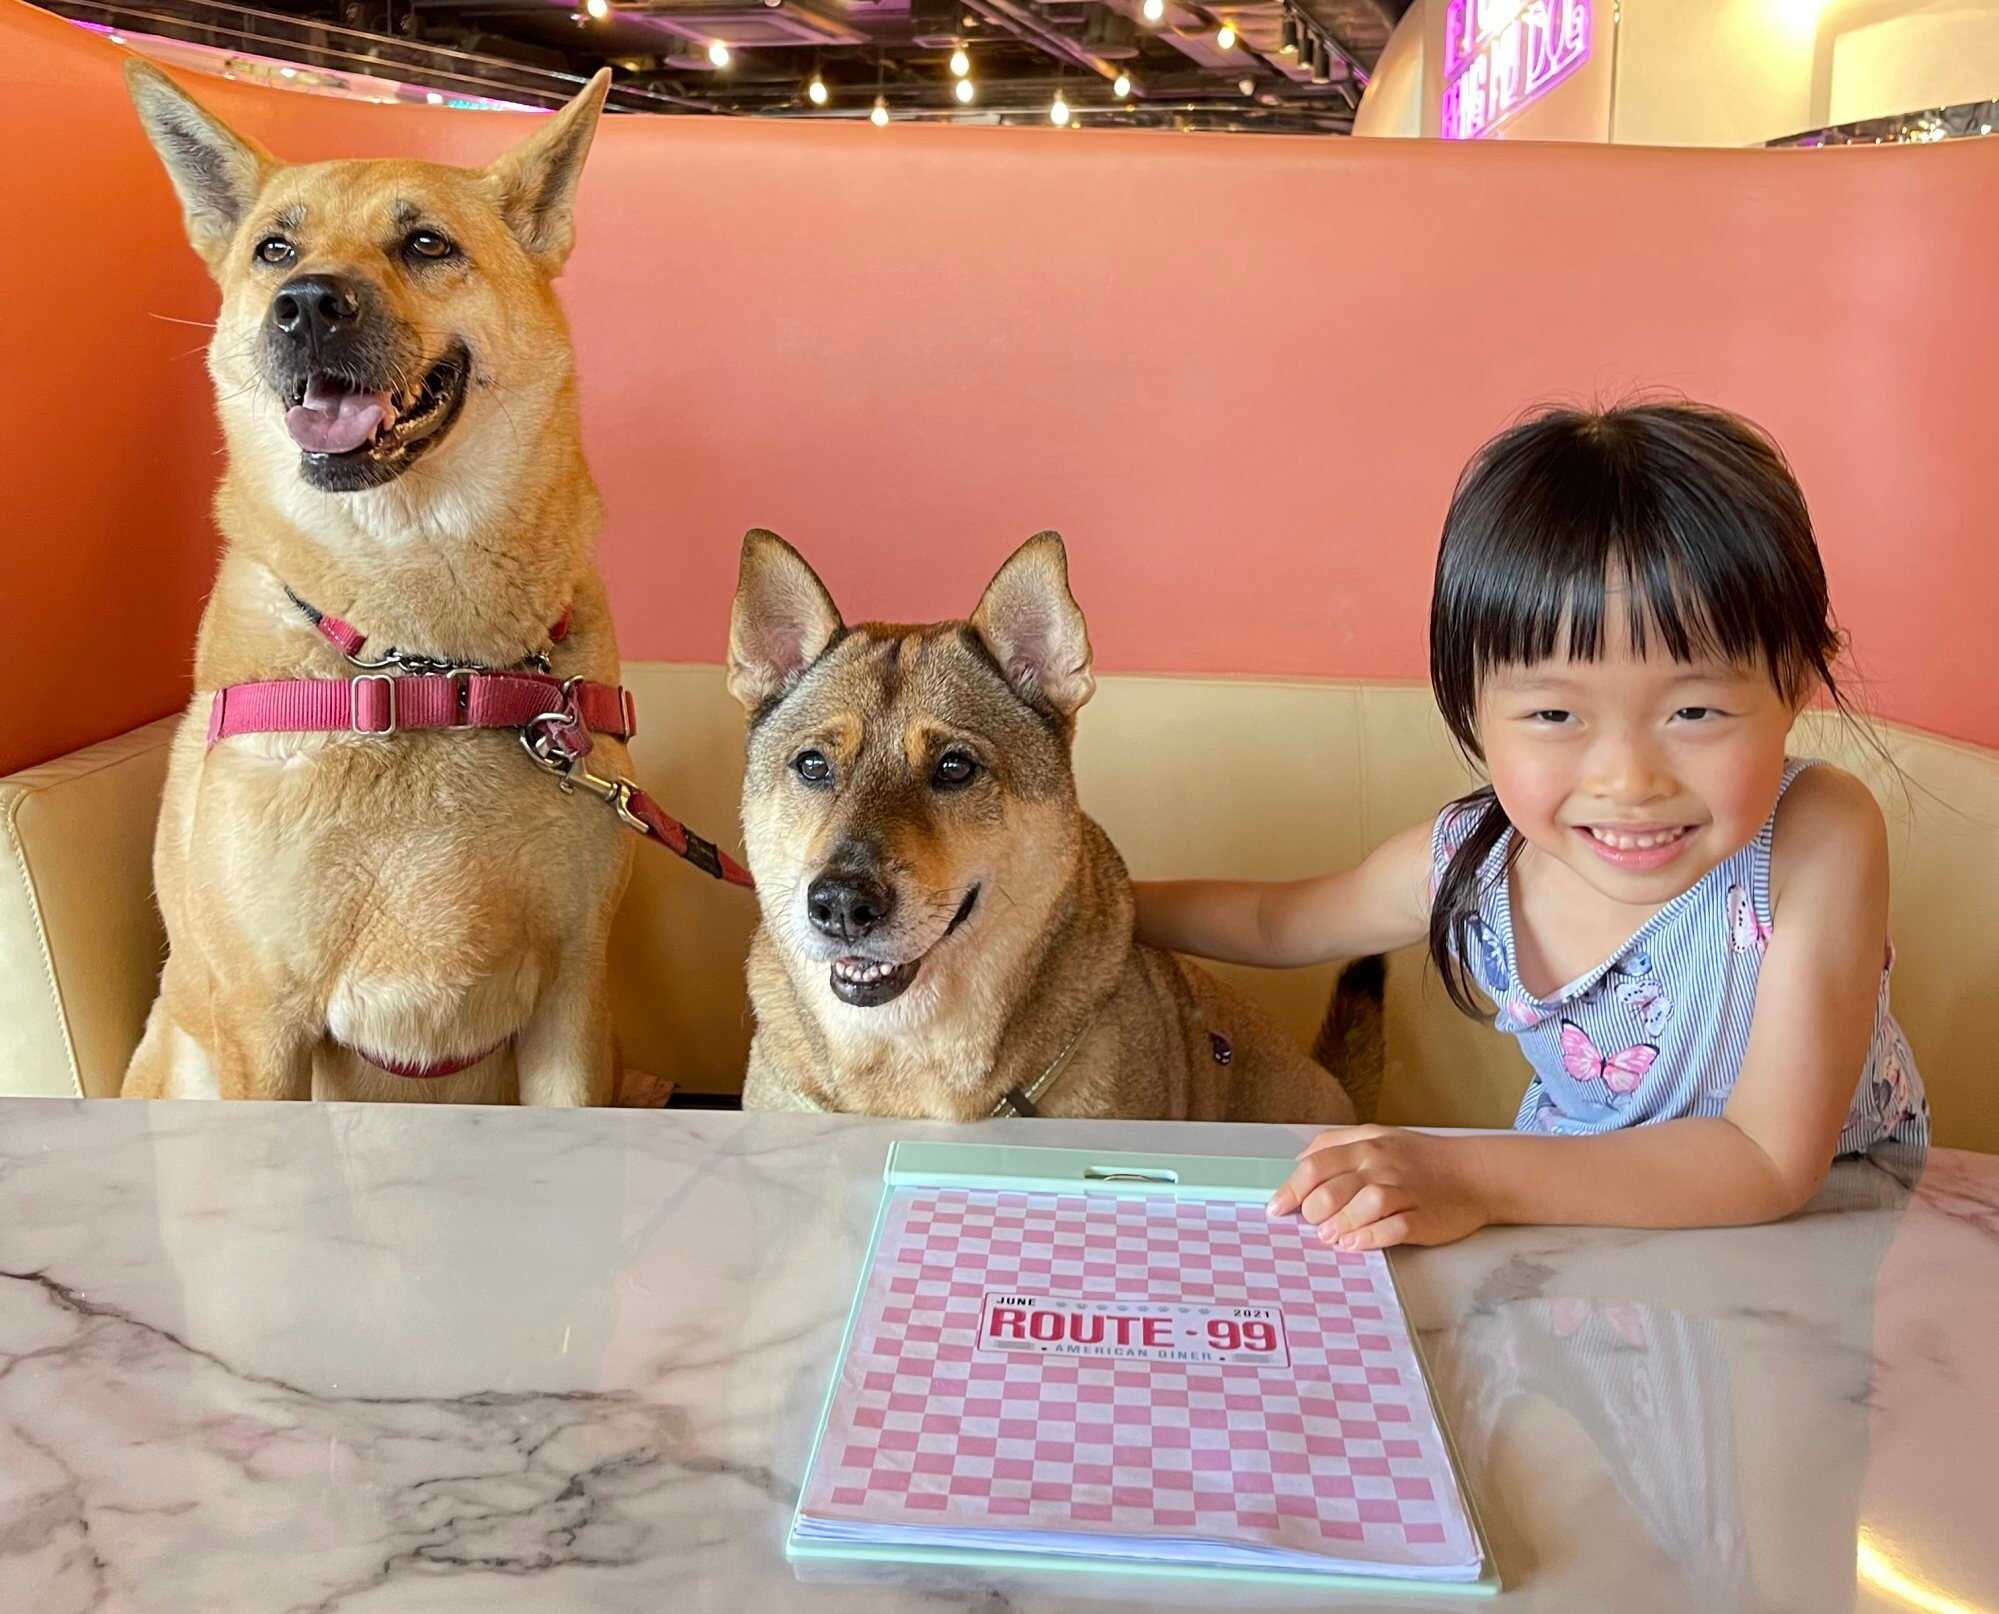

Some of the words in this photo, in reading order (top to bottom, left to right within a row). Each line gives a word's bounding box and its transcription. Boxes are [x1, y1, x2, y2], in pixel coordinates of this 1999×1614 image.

[996, 1296, 1036, 1306] JUNE
[1233, 1309, 1270, 1319] 2021
[990, 1307, 1175, 1347] ROUTE
[1207, 1319, 1277, 1352] 99
[1055, 1343, 1148, 1358] AMERICAN
[1158, 1349, 1212, 1361] DINER
